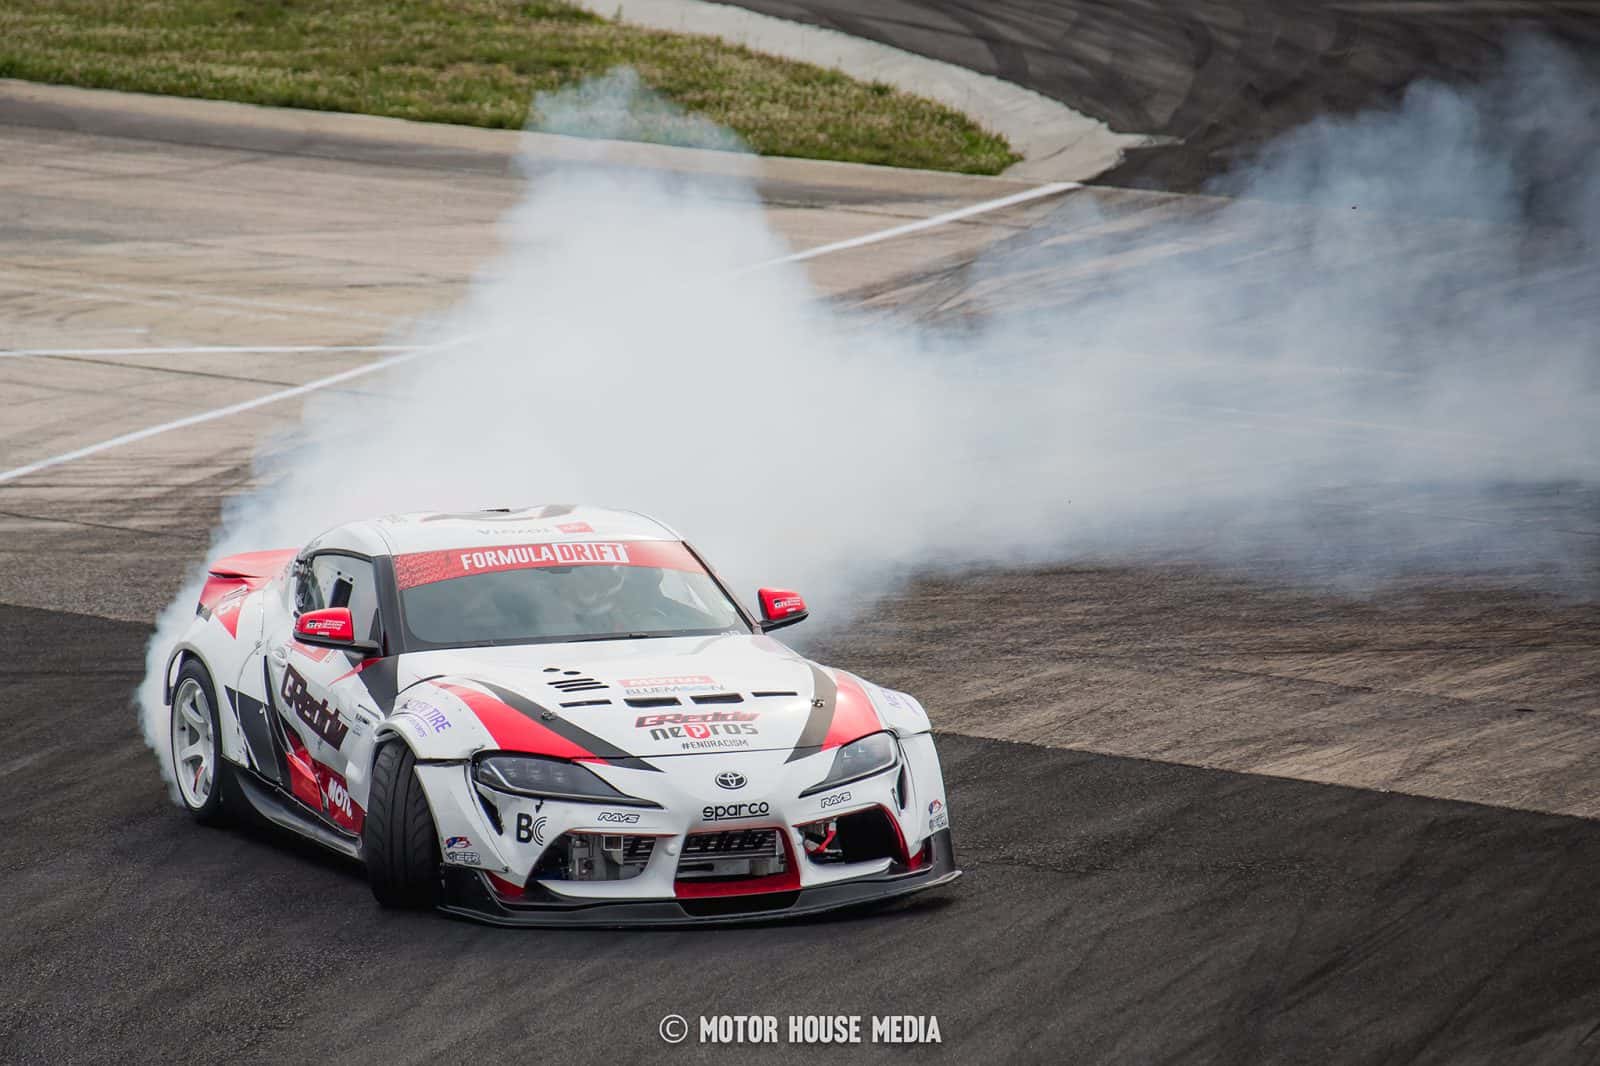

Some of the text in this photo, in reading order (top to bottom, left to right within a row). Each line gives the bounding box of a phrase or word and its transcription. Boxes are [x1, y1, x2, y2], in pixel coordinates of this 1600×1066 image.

[461, 543, 629, 570] FORMULA DRIFT
[424, 708, 452, 733] TIRE
[681, 739, 749, 750] #ENDRACISM
[820, 791, 852, 808] RAYS
[598, 812, 641, 824] RAYS
[702, 801, 770, 821] sparco
